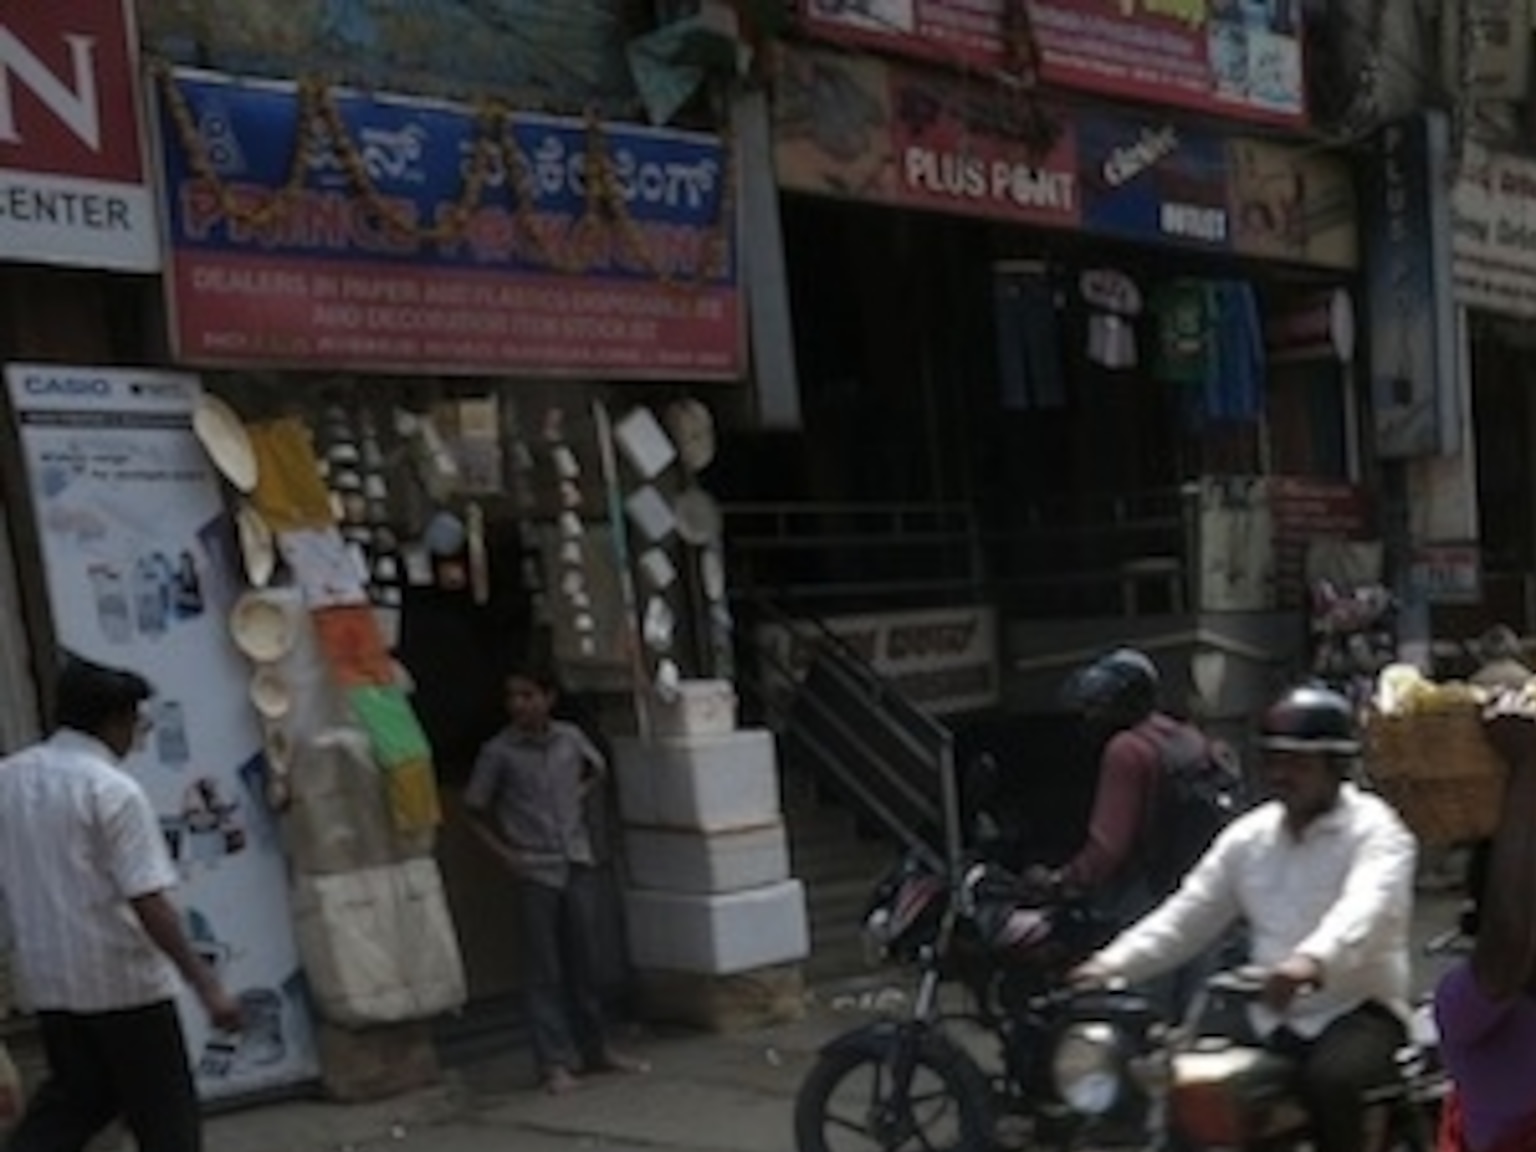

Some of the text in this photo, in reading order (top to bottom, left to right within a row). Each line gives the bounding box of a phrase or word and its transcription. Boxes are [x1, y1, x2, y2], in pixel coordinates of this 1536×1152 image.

[0, 22, 103, 156] N
[904, 146, 988, 200] PLUS
[0, 187, 131, 231] ENTER
[192, 266, 309, 296] DEALERS
[25, 377, 111, 396] CASIO
